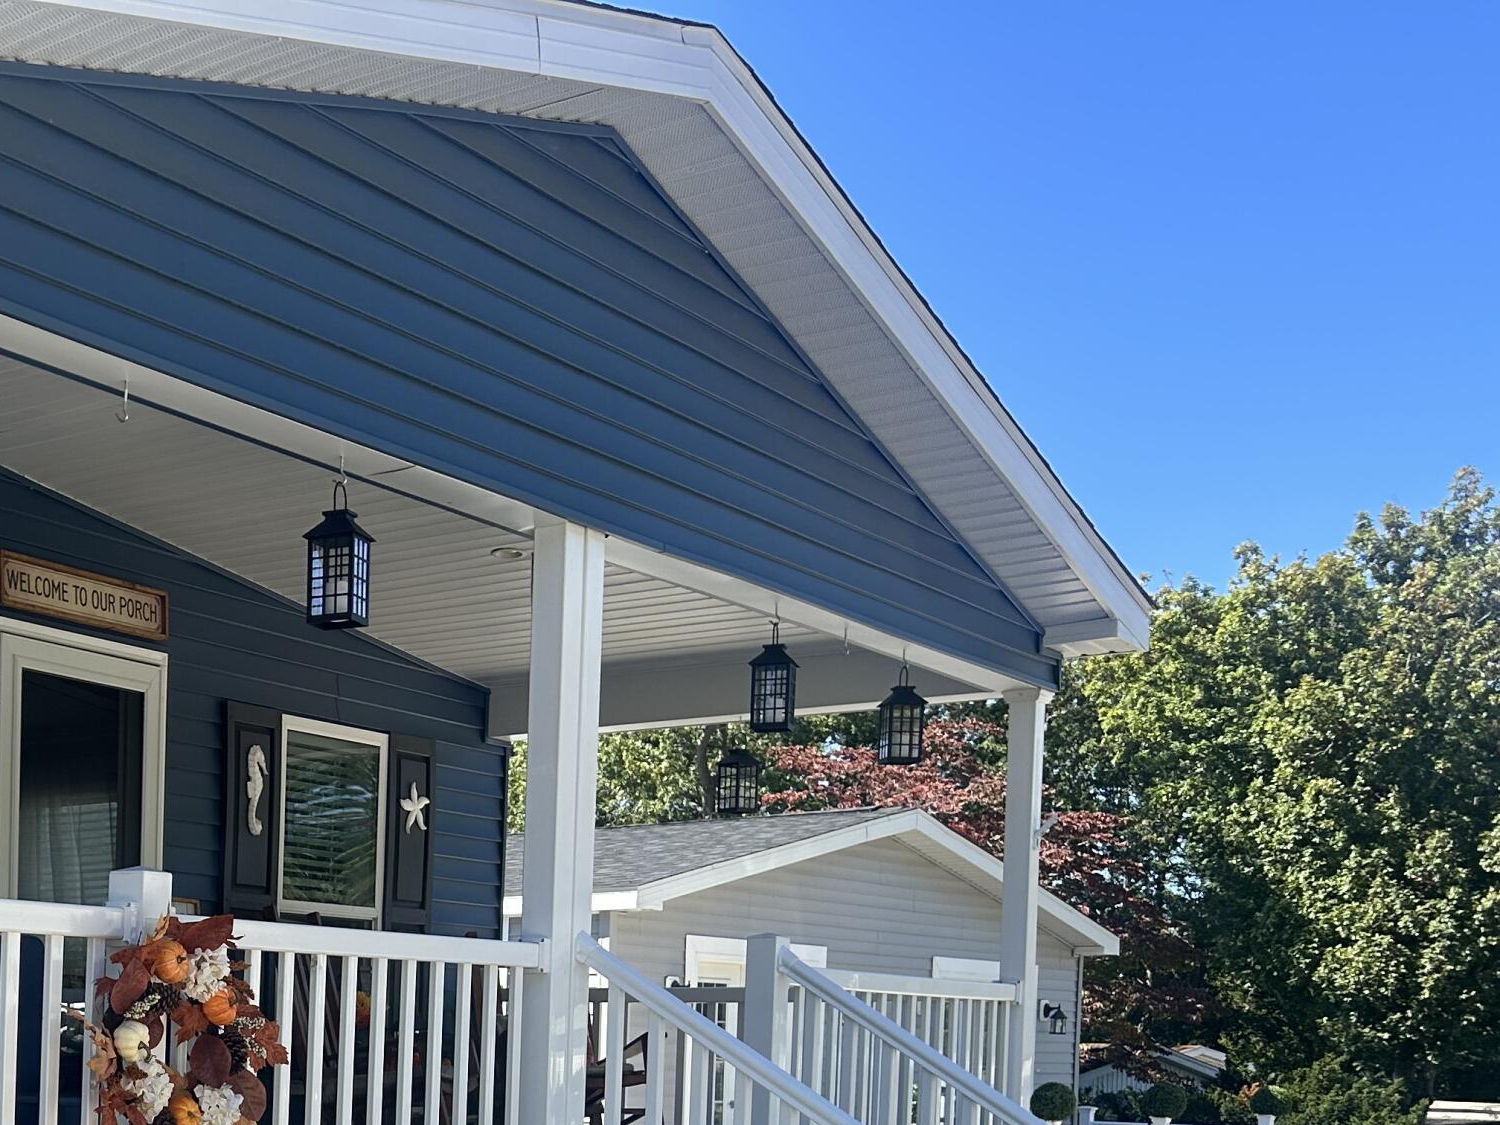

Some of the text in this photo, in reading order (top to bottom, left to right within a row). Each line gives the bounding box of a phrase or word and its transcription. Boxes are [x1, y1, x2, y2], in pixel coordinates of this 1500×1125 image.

[6, 568, 158, 623] WELCOME TO OUR PORCH
